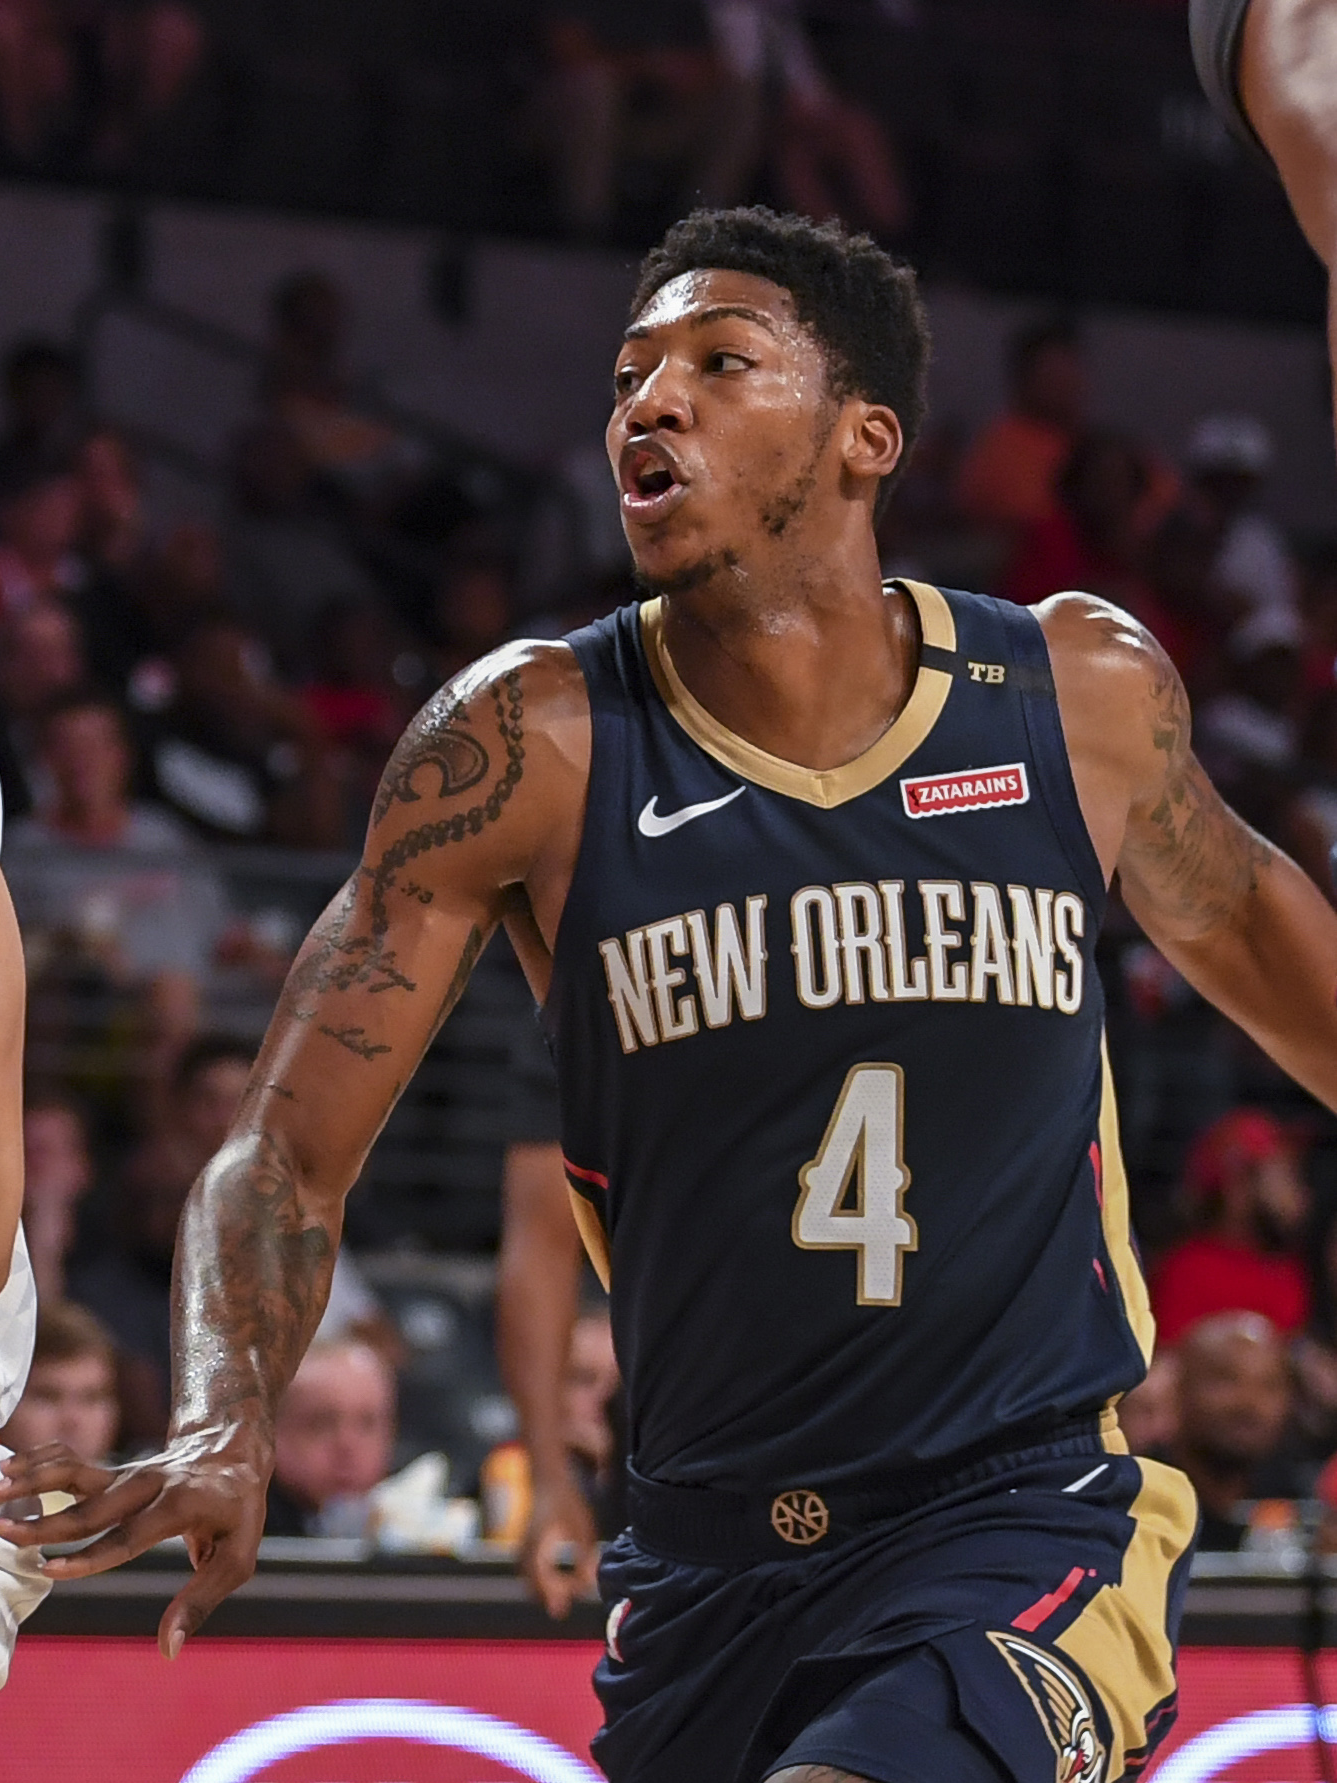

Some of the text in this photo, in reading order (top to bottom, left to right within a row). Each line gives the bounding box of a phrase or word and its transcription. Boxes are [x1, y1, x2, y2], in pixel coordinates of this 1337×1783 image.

[967, 661, 1005, 684] TB
[918, 775, 1018, 803] ZATARAIN'S
[598, 880, 1084, 1054] NEW ORLEANS
[791, 1062, 918, 1307] 4
